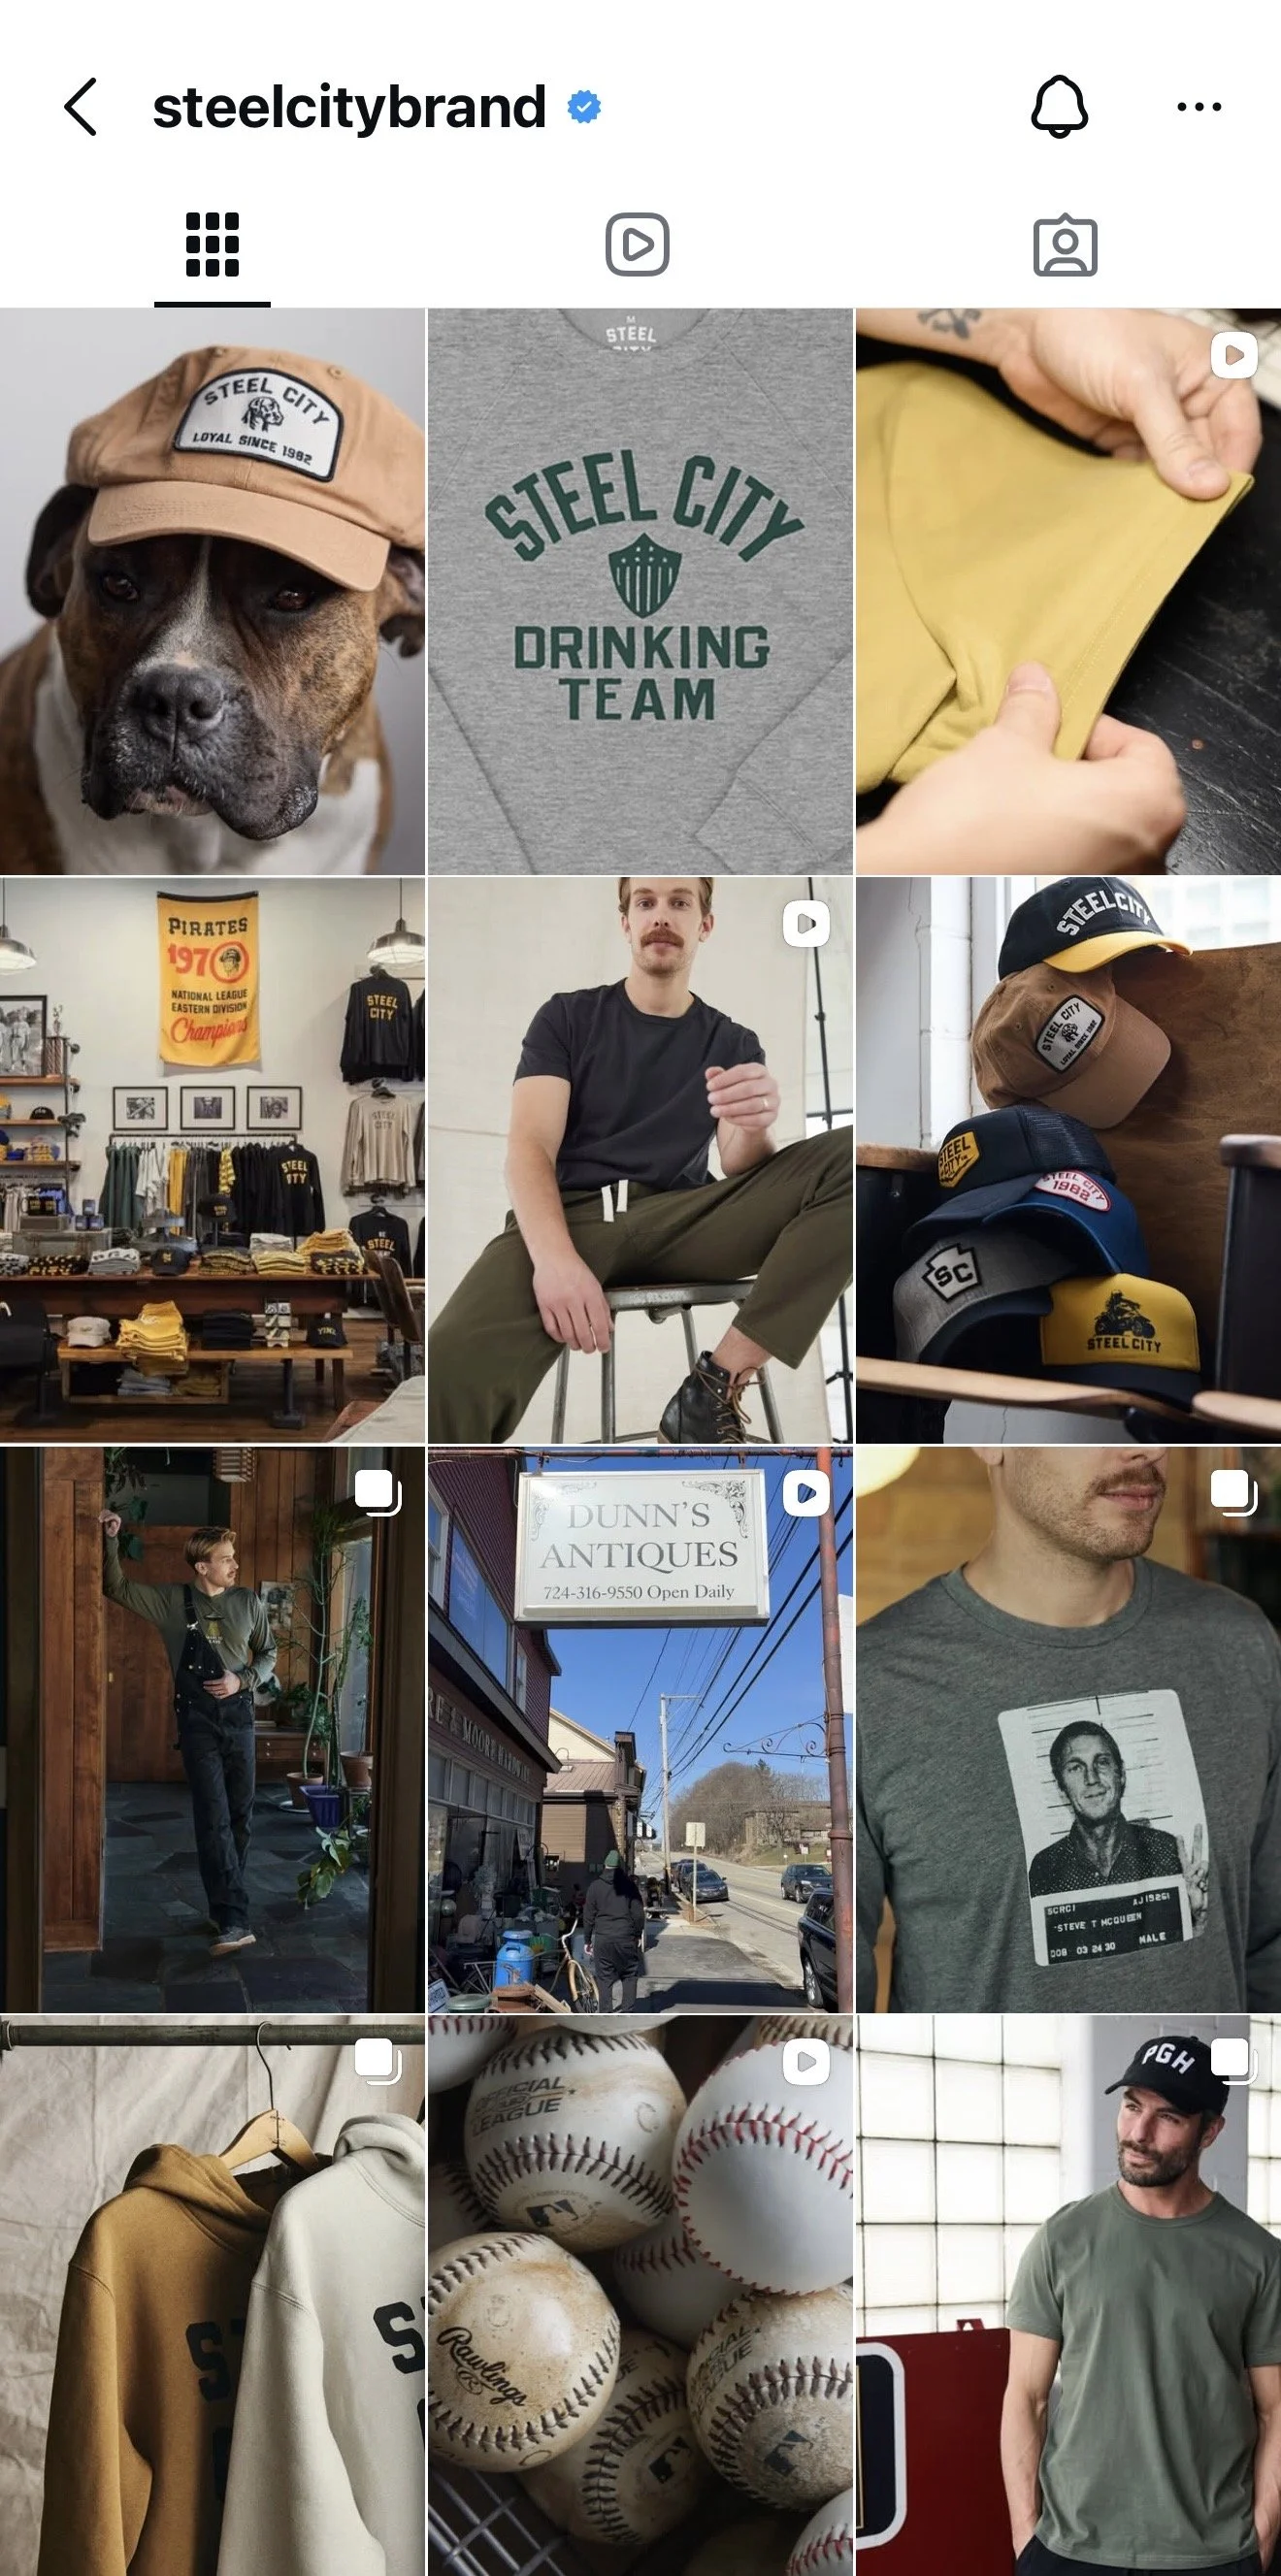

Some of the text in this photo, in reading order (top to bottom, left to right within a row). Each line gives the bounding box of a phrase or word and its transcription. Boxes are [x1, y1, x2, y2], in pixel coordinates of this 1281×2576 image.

[153, 82, 545, 139] steelcitybrand
[606, 325, 657, 343] STEEL
[204, 377, 331, 425] STEEL CITY
[193, 432, 312, 466] LOYAL SINCE 1982
[484, 448, 805, 563] STEEL CITY
[514, 626, 771, 669] DRINKING
[559, 677, 715, 721] TEAM
[168, 916, 248, 936] PIRATES
[171, 989, 248, 1001] NATIONAL LEAGUE
[171, 1001, 247, 1014] EASTERN DIVISION
[367, 995, 398, 1009] STEEL
[370, 1008, 395, 1021] CITY
[1041, 1002, 1081, 1052] STEEL CITY
[170, 1016, 248, 1049] Champions
[939, 1136, 970, 1168] STEEL
[943, 1154, 961, 1175] CITY
[281, 1159, 308, 1173] STEEL
[1041, 1172, 1105, 1200] STEEL CITY
[1053, 1180, 1091, 1202] 1982
[367, 1238, 396, 1252] STEEL
[935, 1264, 973, 1288] SC
[1088, 1337, 1162, 1353] STEEL CITY
[568, 1501, 710, 1529] DUNN'S
[539, 1541, 739, 1574] ANTIQUES
[543, 1583, 736, 1602] 724-316-9550 Open Daily
[1092, 1919, 1098, 1928] T
[1100, 1912, 1143, 1927] MCQUEEN
[1076, 1945, 1089, 1955] 03
[1092, 1943, 1102, 1954] 24
[1104, 1941, 1116, 1952] 30
[1138, 1932, 1166, 1945] MALE
[1141, 2042, 1196, 2074] PGH
[472, 2098, 563, 2136] LEAGUE
[373, 2300, 425, 2374] S
[436, 2327, 527, 2406] Rawlings
